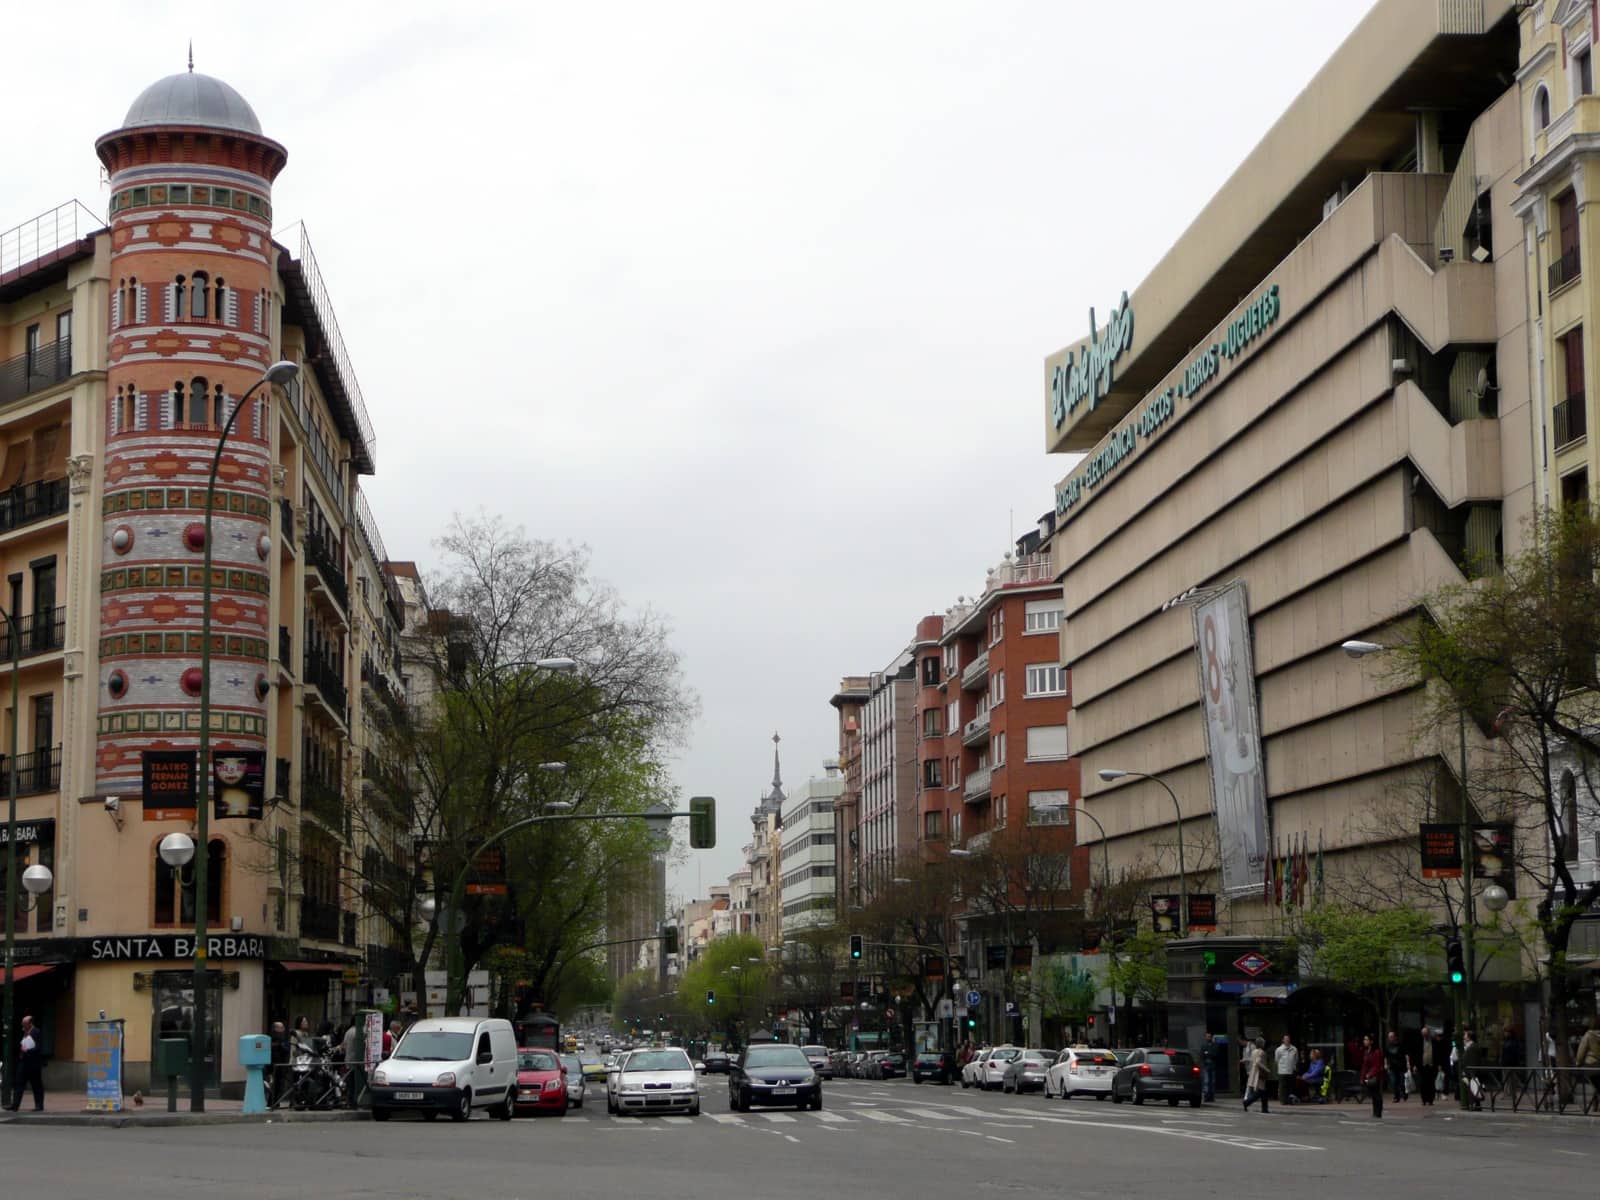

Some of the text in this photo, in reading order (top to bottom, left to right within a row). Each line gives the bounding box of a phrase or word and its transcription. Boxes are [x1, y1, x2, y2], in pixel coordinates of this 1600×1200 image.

[1056, 478, 1081, 517] HOGAR
[1142, 387, 1174, 438] DISCOS
[1183, 344, 1220, 399] LIBROS
[1226, 284, 1280, 360] JUGUETES
[1062, 344, 1090, 412] Corte
[1204, 614, 1221, 705] 8
[2, 826, 38, 843] BBARA
[91, 938, 163, 958] SANTA
